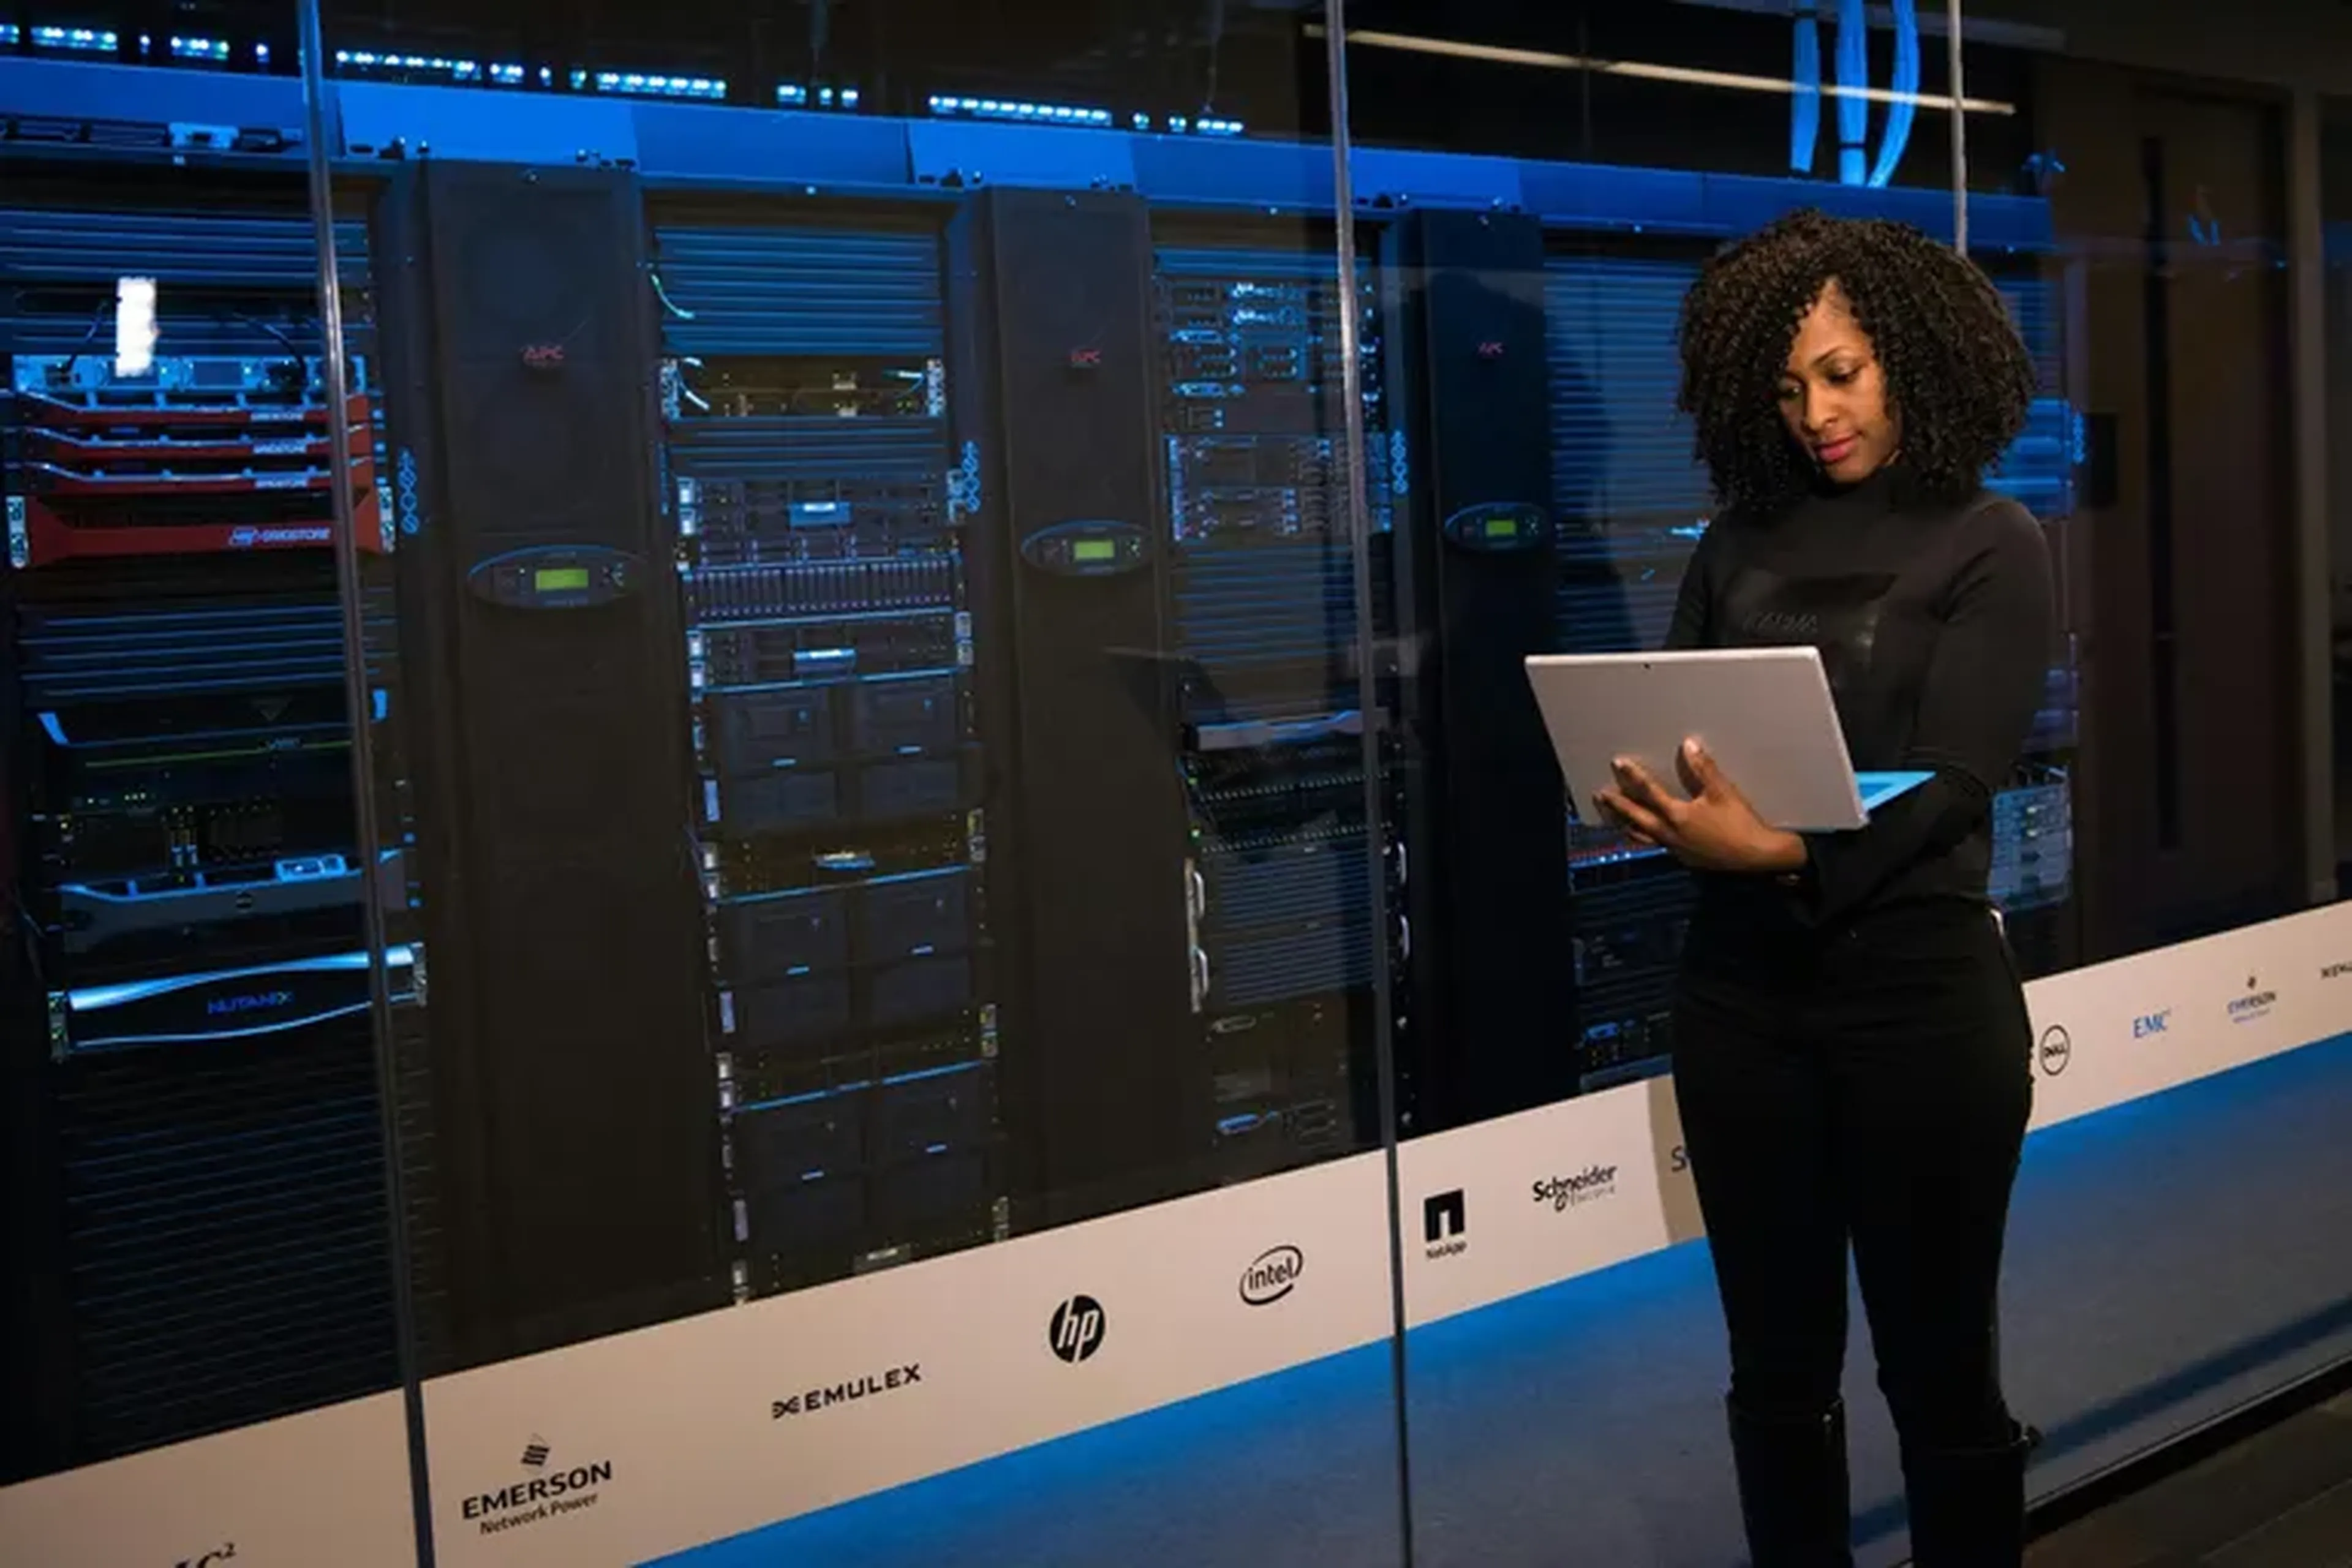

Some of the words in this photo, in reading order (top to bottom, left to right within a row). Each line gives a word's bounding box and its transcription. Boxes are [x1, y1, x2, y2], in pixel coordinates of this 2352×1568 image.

[1532, 1165, 1617, 1213] Schneider
[1248, 1256, 1294, 1289] intel
[1426, 1241, 1467, 1259] NetApp
[1057, 1295, 1100, 1362] hp
[804, 1363, 921, 1411] EMULEX
[462, 1460, 611, 1520] EMERSON
[480, 1504, 549, 1534] Network
[550, 1493, 598, 1516] Power
